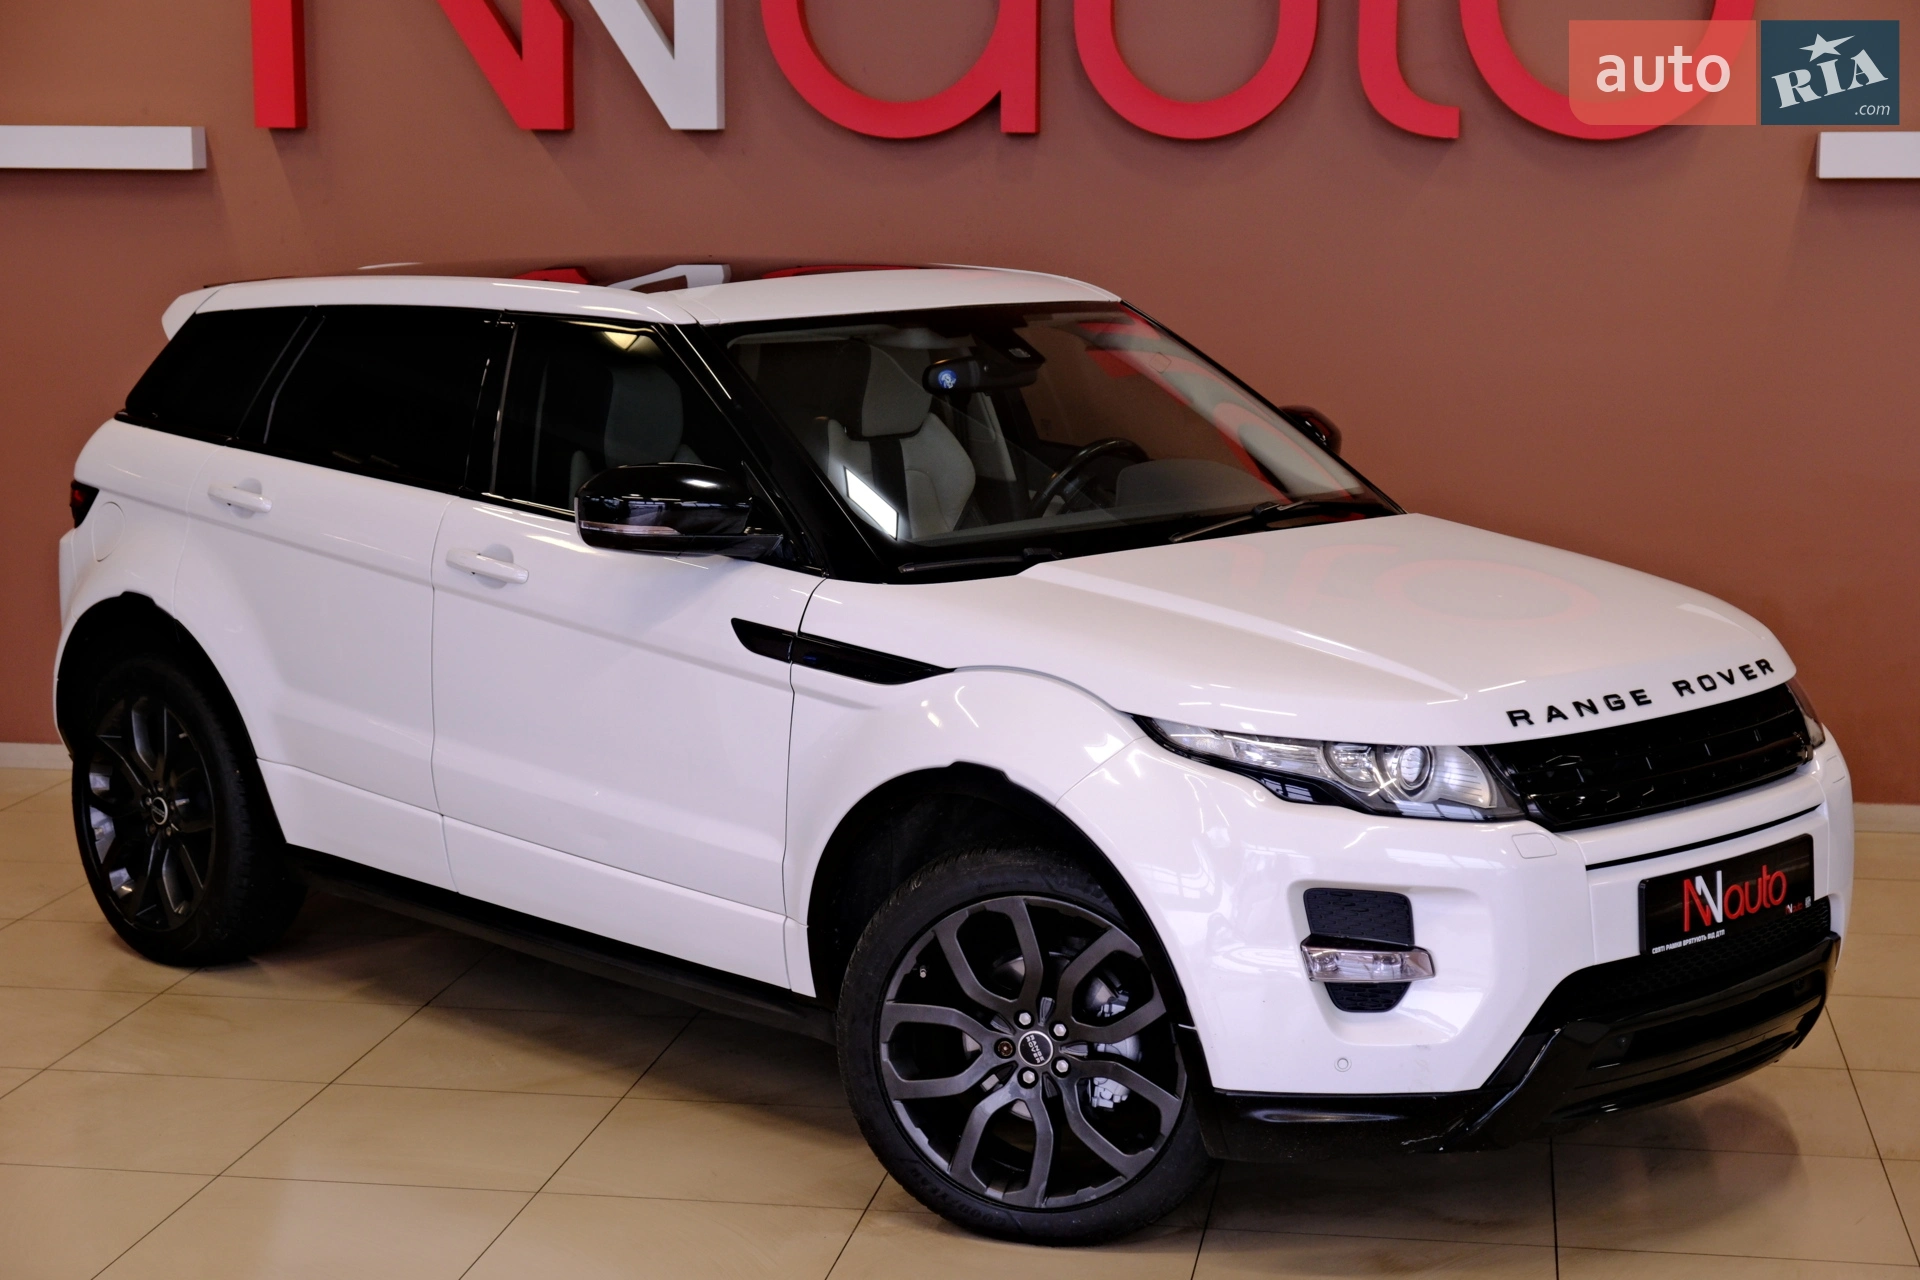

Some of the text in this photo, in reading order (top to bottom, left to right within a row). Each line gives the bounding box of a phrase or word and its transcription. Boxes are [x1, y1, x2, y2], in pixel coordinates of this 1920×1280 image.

[1506, 658, 1775, 727] RANGE ROVER
[1025, 1036, 1041, 1064] ROVER
[1029, 1034, 1045, 1062] RANGE
